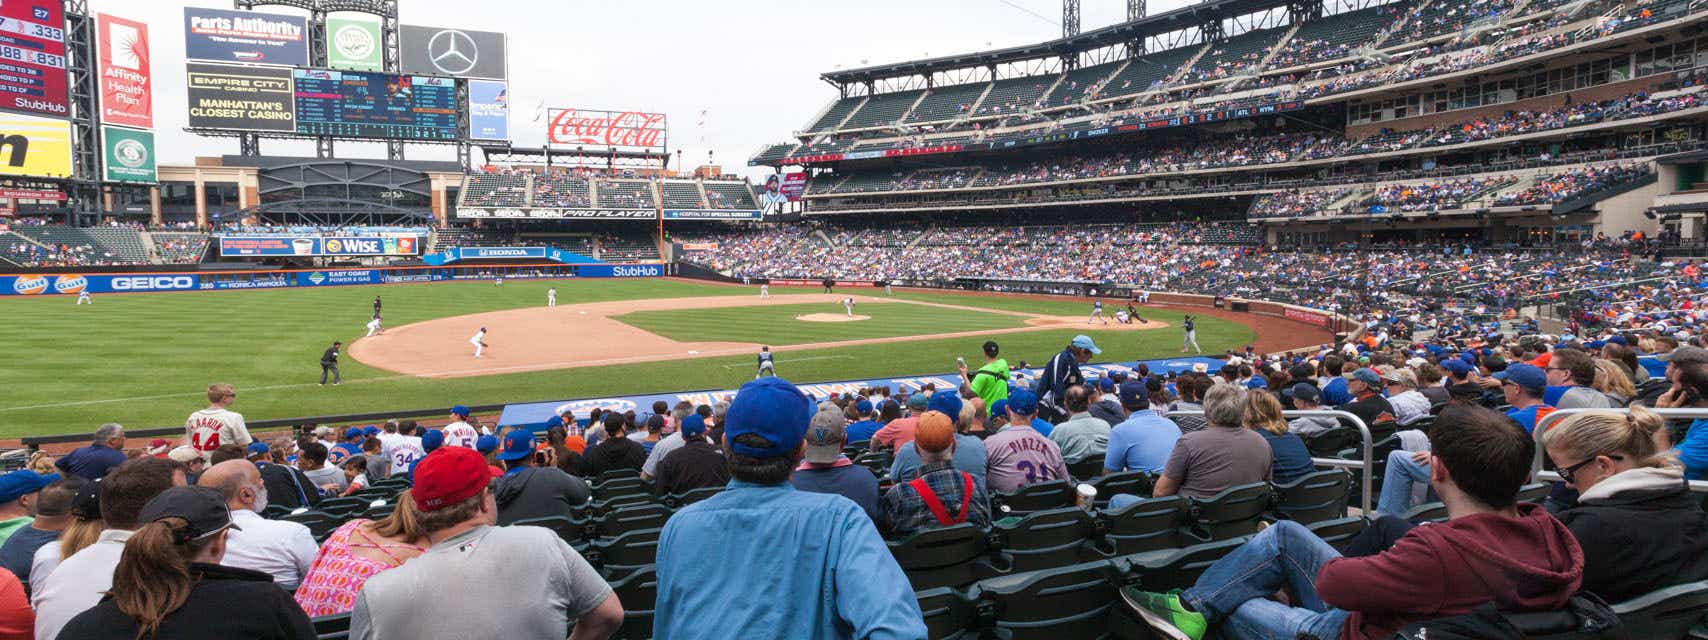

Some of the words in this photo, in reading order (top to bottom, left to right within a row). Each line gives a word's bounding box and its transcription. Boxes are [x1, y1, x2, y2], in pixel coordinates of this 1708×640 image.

[34, 8, 49, 18] 27
[31, 24, 61, 40] .333
[191, 16, 232, 30] Parts
[233, 17, 301, 36] Authority
[0, 46, 21, 60] 88
[105, 67, 146, 84] Affinity
[194, 77, 250, 87] EMPIRE
[108, 80, 145, 96] Health
[15, 97, 66, 113] StubHub
[116, 93, 140, 105] Plan
[199, 98, 283, 111] MANHATTAN'S
[190, 107, 245, 118] CLOSEST
[247, 110, 292, 121] CASINO
[597, 210, 654, 218] PLAYER
[343, 239, 380, 253] WISE
[613, 265, 658, 277] StubHub
[111, 276, 193, 290] GEICO
[229, 281, 256, 289] KONICA
[1008, 437, 1048, 454] PIAZZA
[396, 452, 413, 468] 34
